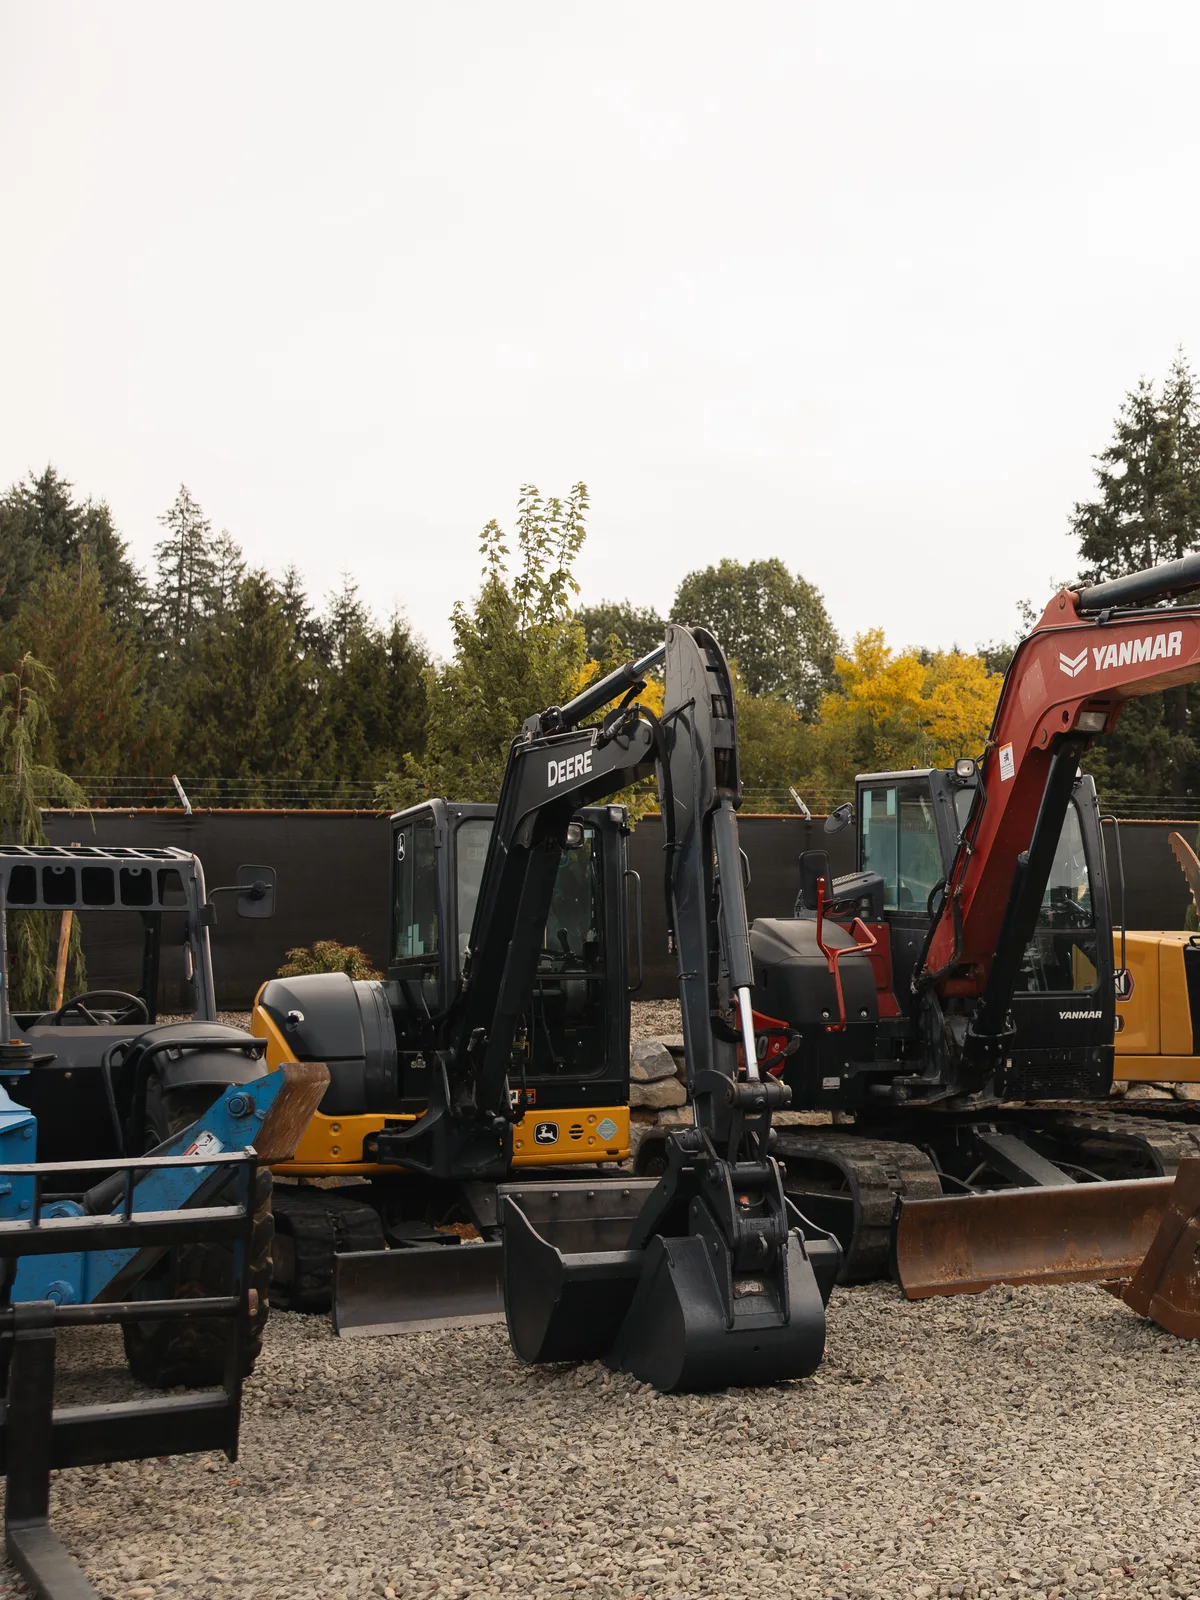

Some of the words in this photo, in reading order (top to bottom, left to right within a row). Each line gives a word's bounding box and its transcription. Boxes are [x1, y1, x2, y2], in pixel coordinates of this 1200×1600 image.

[1092, 630, 1183, 671] YANMAR
[547, 749, 593, 788] DEERE
[1058, 1010, 1103, 1020] YANMAR
